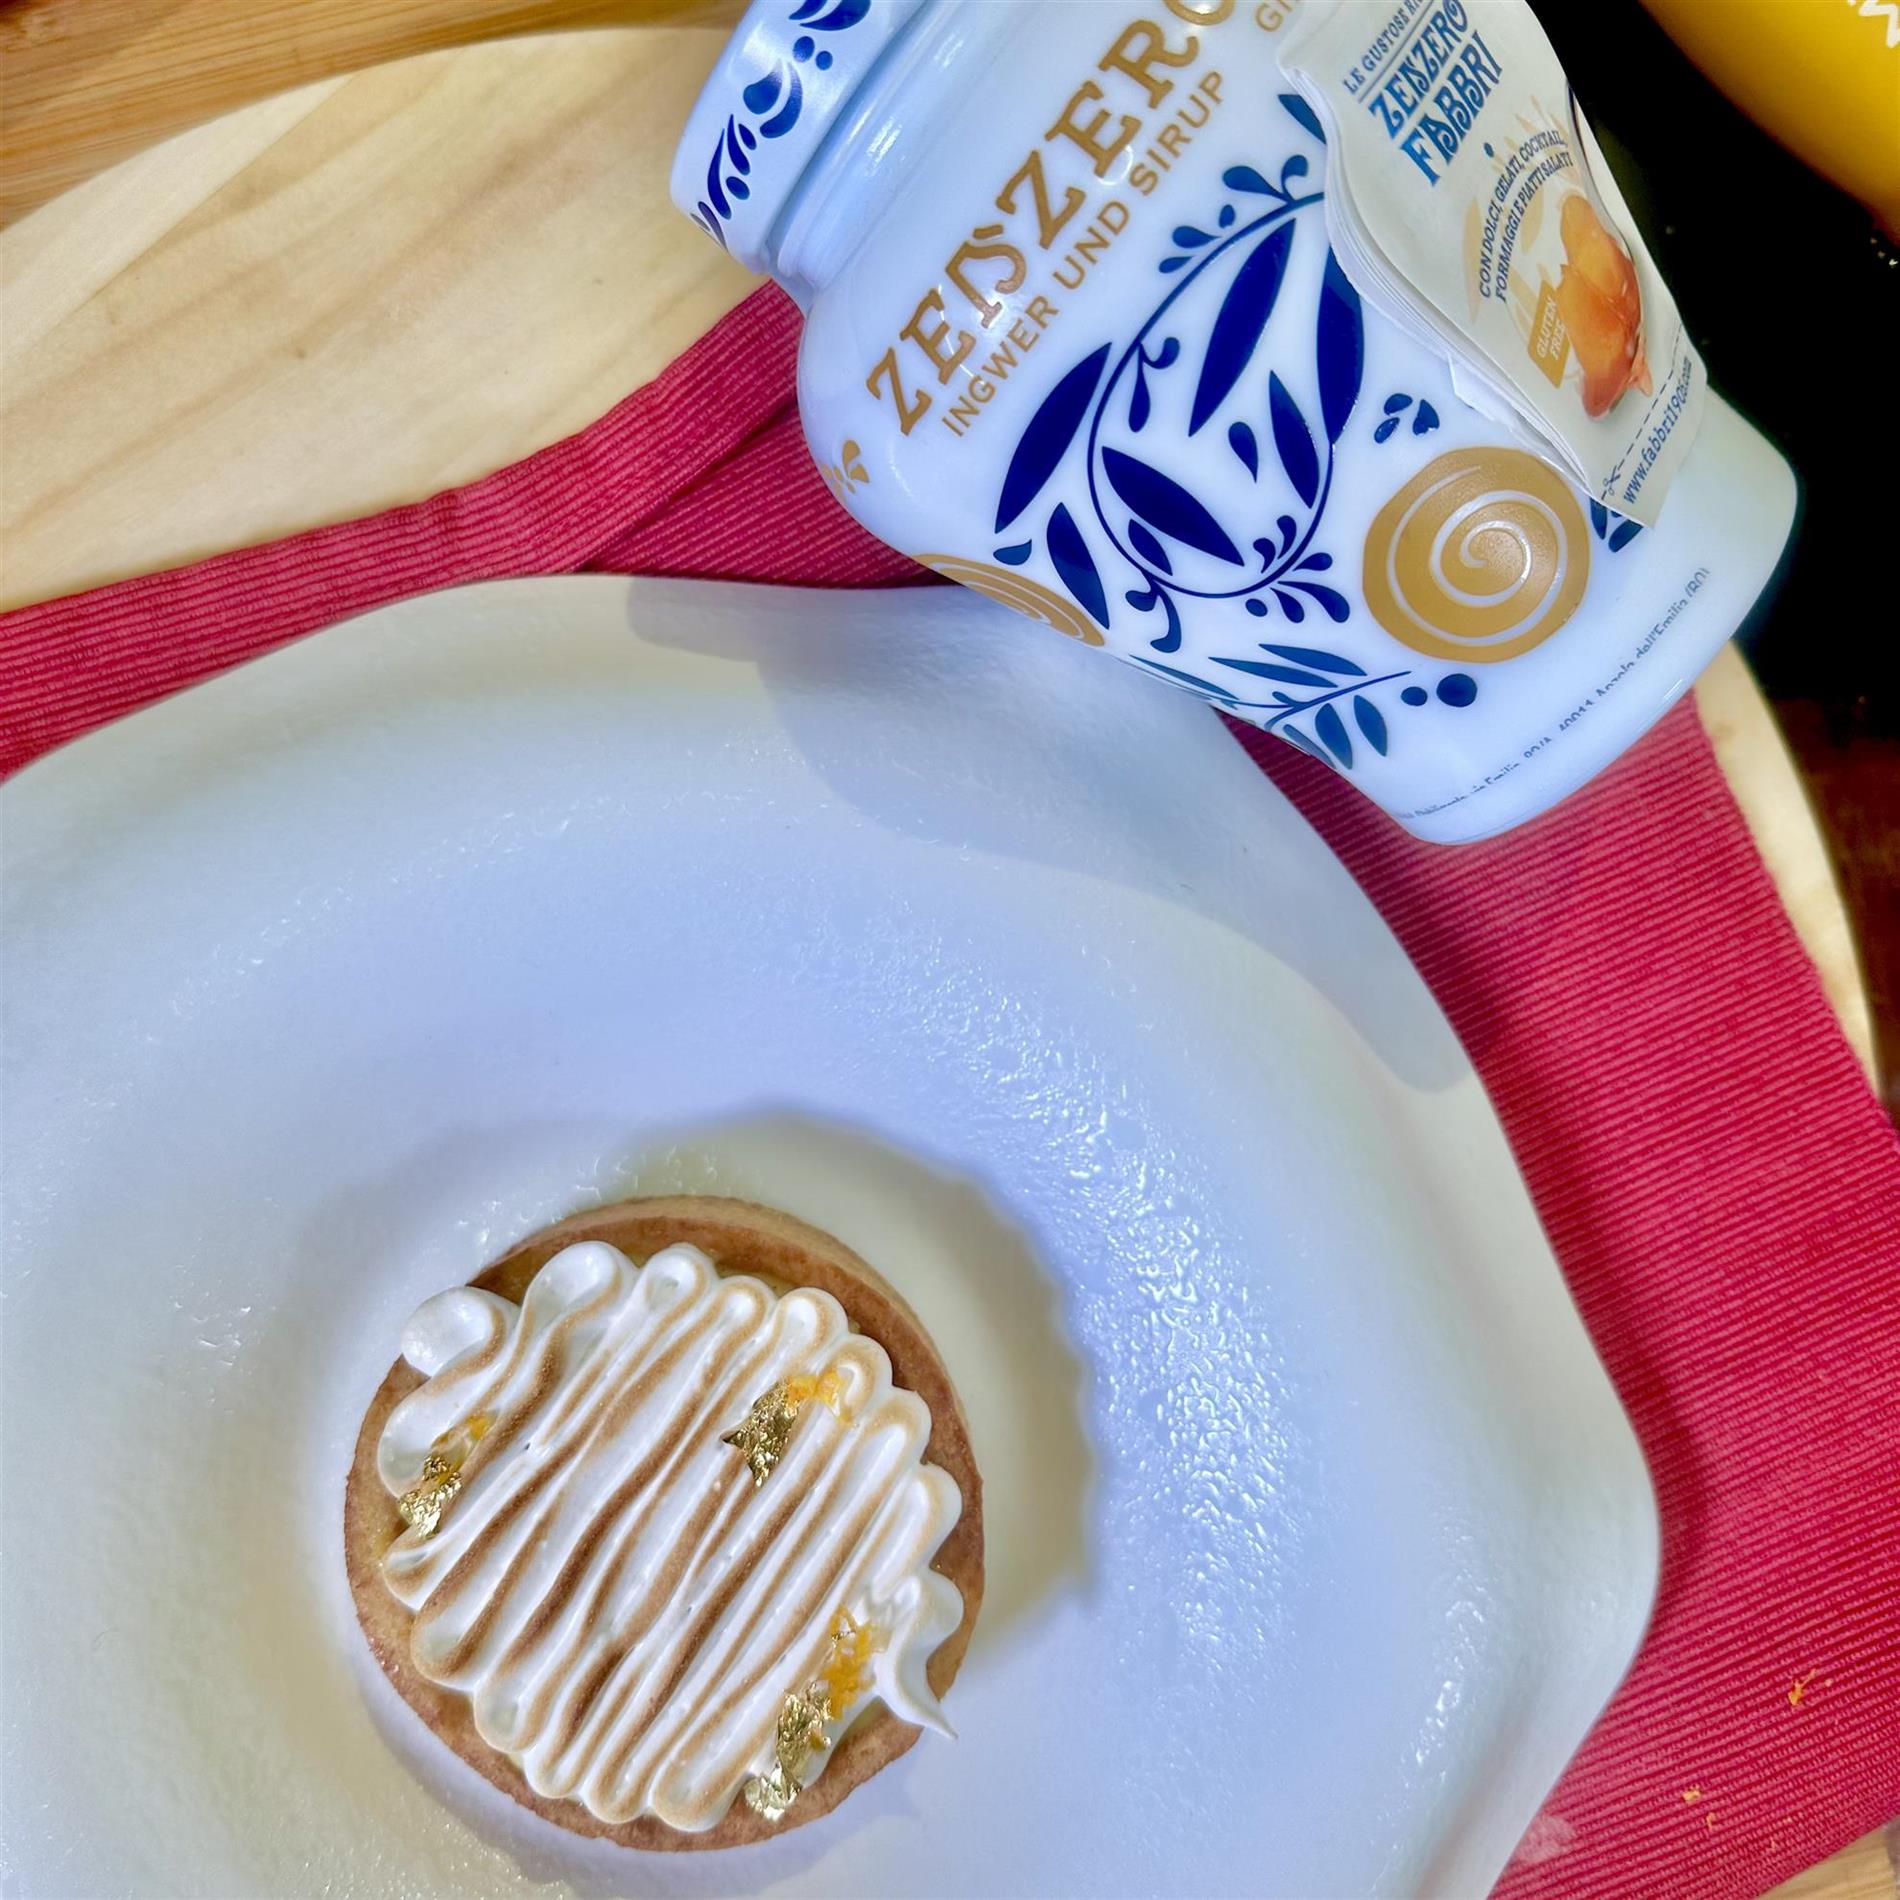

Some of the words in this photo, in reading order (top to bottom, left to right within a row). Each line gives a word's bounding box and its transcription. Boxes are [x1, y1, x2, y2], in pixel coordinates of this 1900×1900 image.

[1343, 67, 1366, 95] LE
[1361, 7, 1410, 72] GUSTOSE
[1399, 29, 1503, 187] FABBRI
[941, 296, 1059, 437] INGWER
[1052, 200, 1130, 290] UND
[1128, 70, 1225, 196] SIRUP
[1495, 209, 1522, 304] FORMAGGI
[1517, 170, 1547, 208] PIATTI
[1540, 151, 1574, 177] SALATI
[1479, 252, 1493, 298] CON
[1536, 294, 1557, 358] GLUTEN
[1550, 319, 1567, 361] FREE
